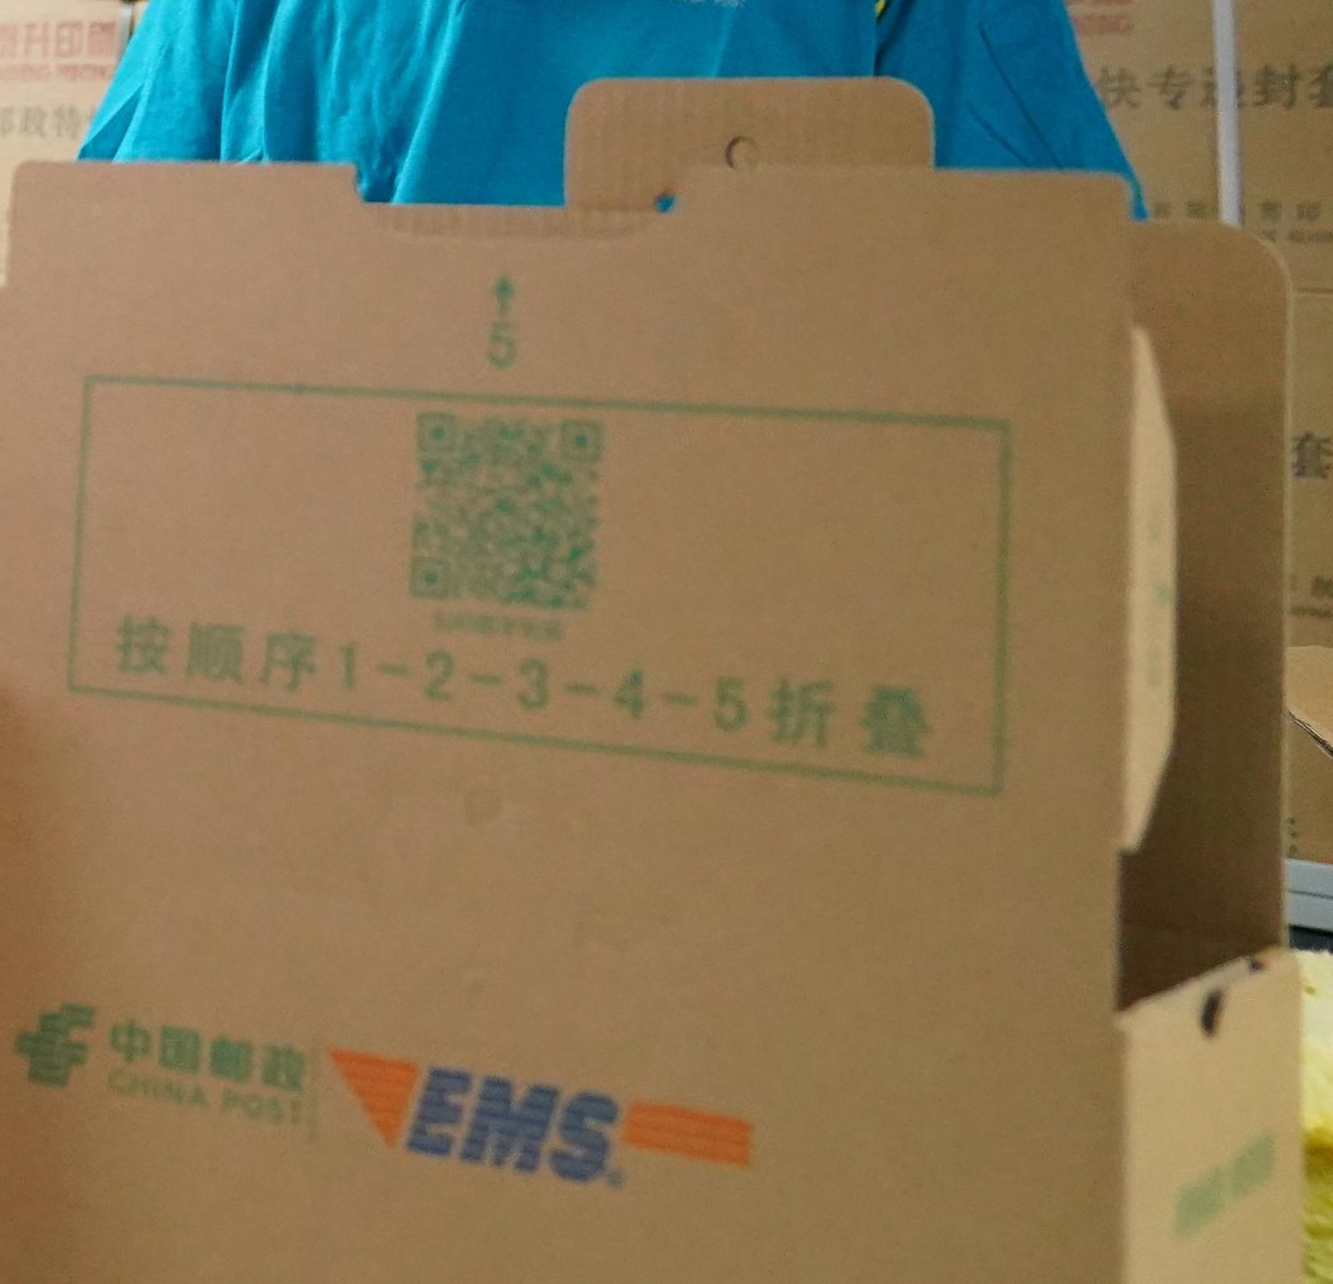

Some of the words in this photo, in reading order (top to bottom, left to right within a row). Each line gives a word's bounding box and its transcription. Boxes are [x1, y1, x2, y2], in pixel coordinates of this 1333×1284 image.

[485, 325, 517, 369] 5
[107, 1068, 207, 1109] CHINA
[109, 1019, 306, 1092] 中国邮政
[406, 1066, 620, 1184] EMS
